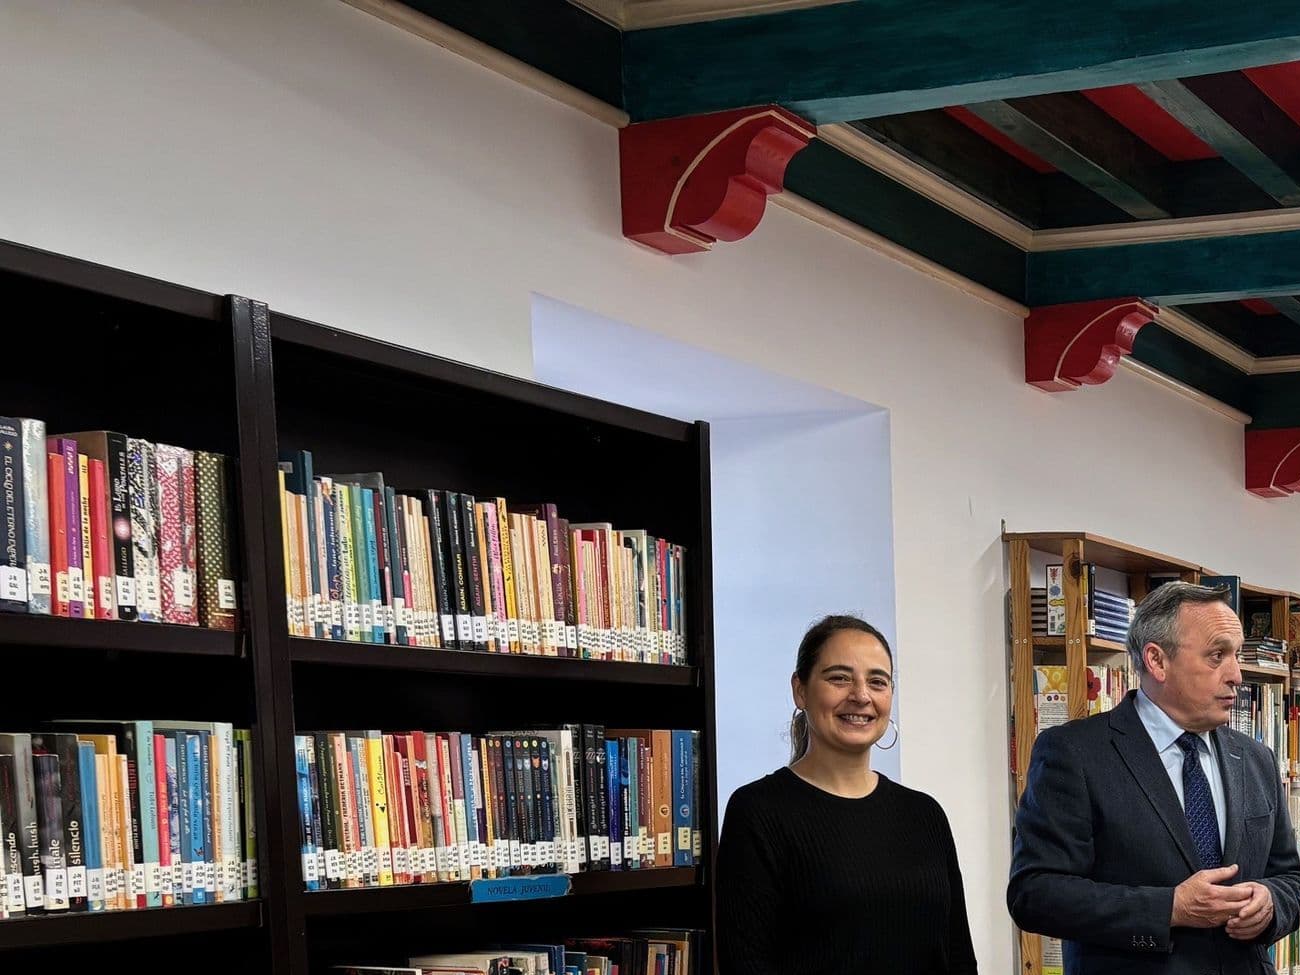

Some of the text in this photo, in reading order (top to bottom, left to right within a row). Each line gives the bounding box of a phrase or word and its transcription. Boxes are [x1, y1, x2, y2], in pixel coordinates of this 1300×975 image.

[456, 553, 464, 585] CONFIAR
[25, 822, 38, 848] hush
[68, 821, 81, 865] silencio
[7, 832, 17, 874] scendo
[49, 839, 61, 869] inale
[488, 884, 551, 896] NOVELA JUVENIL
